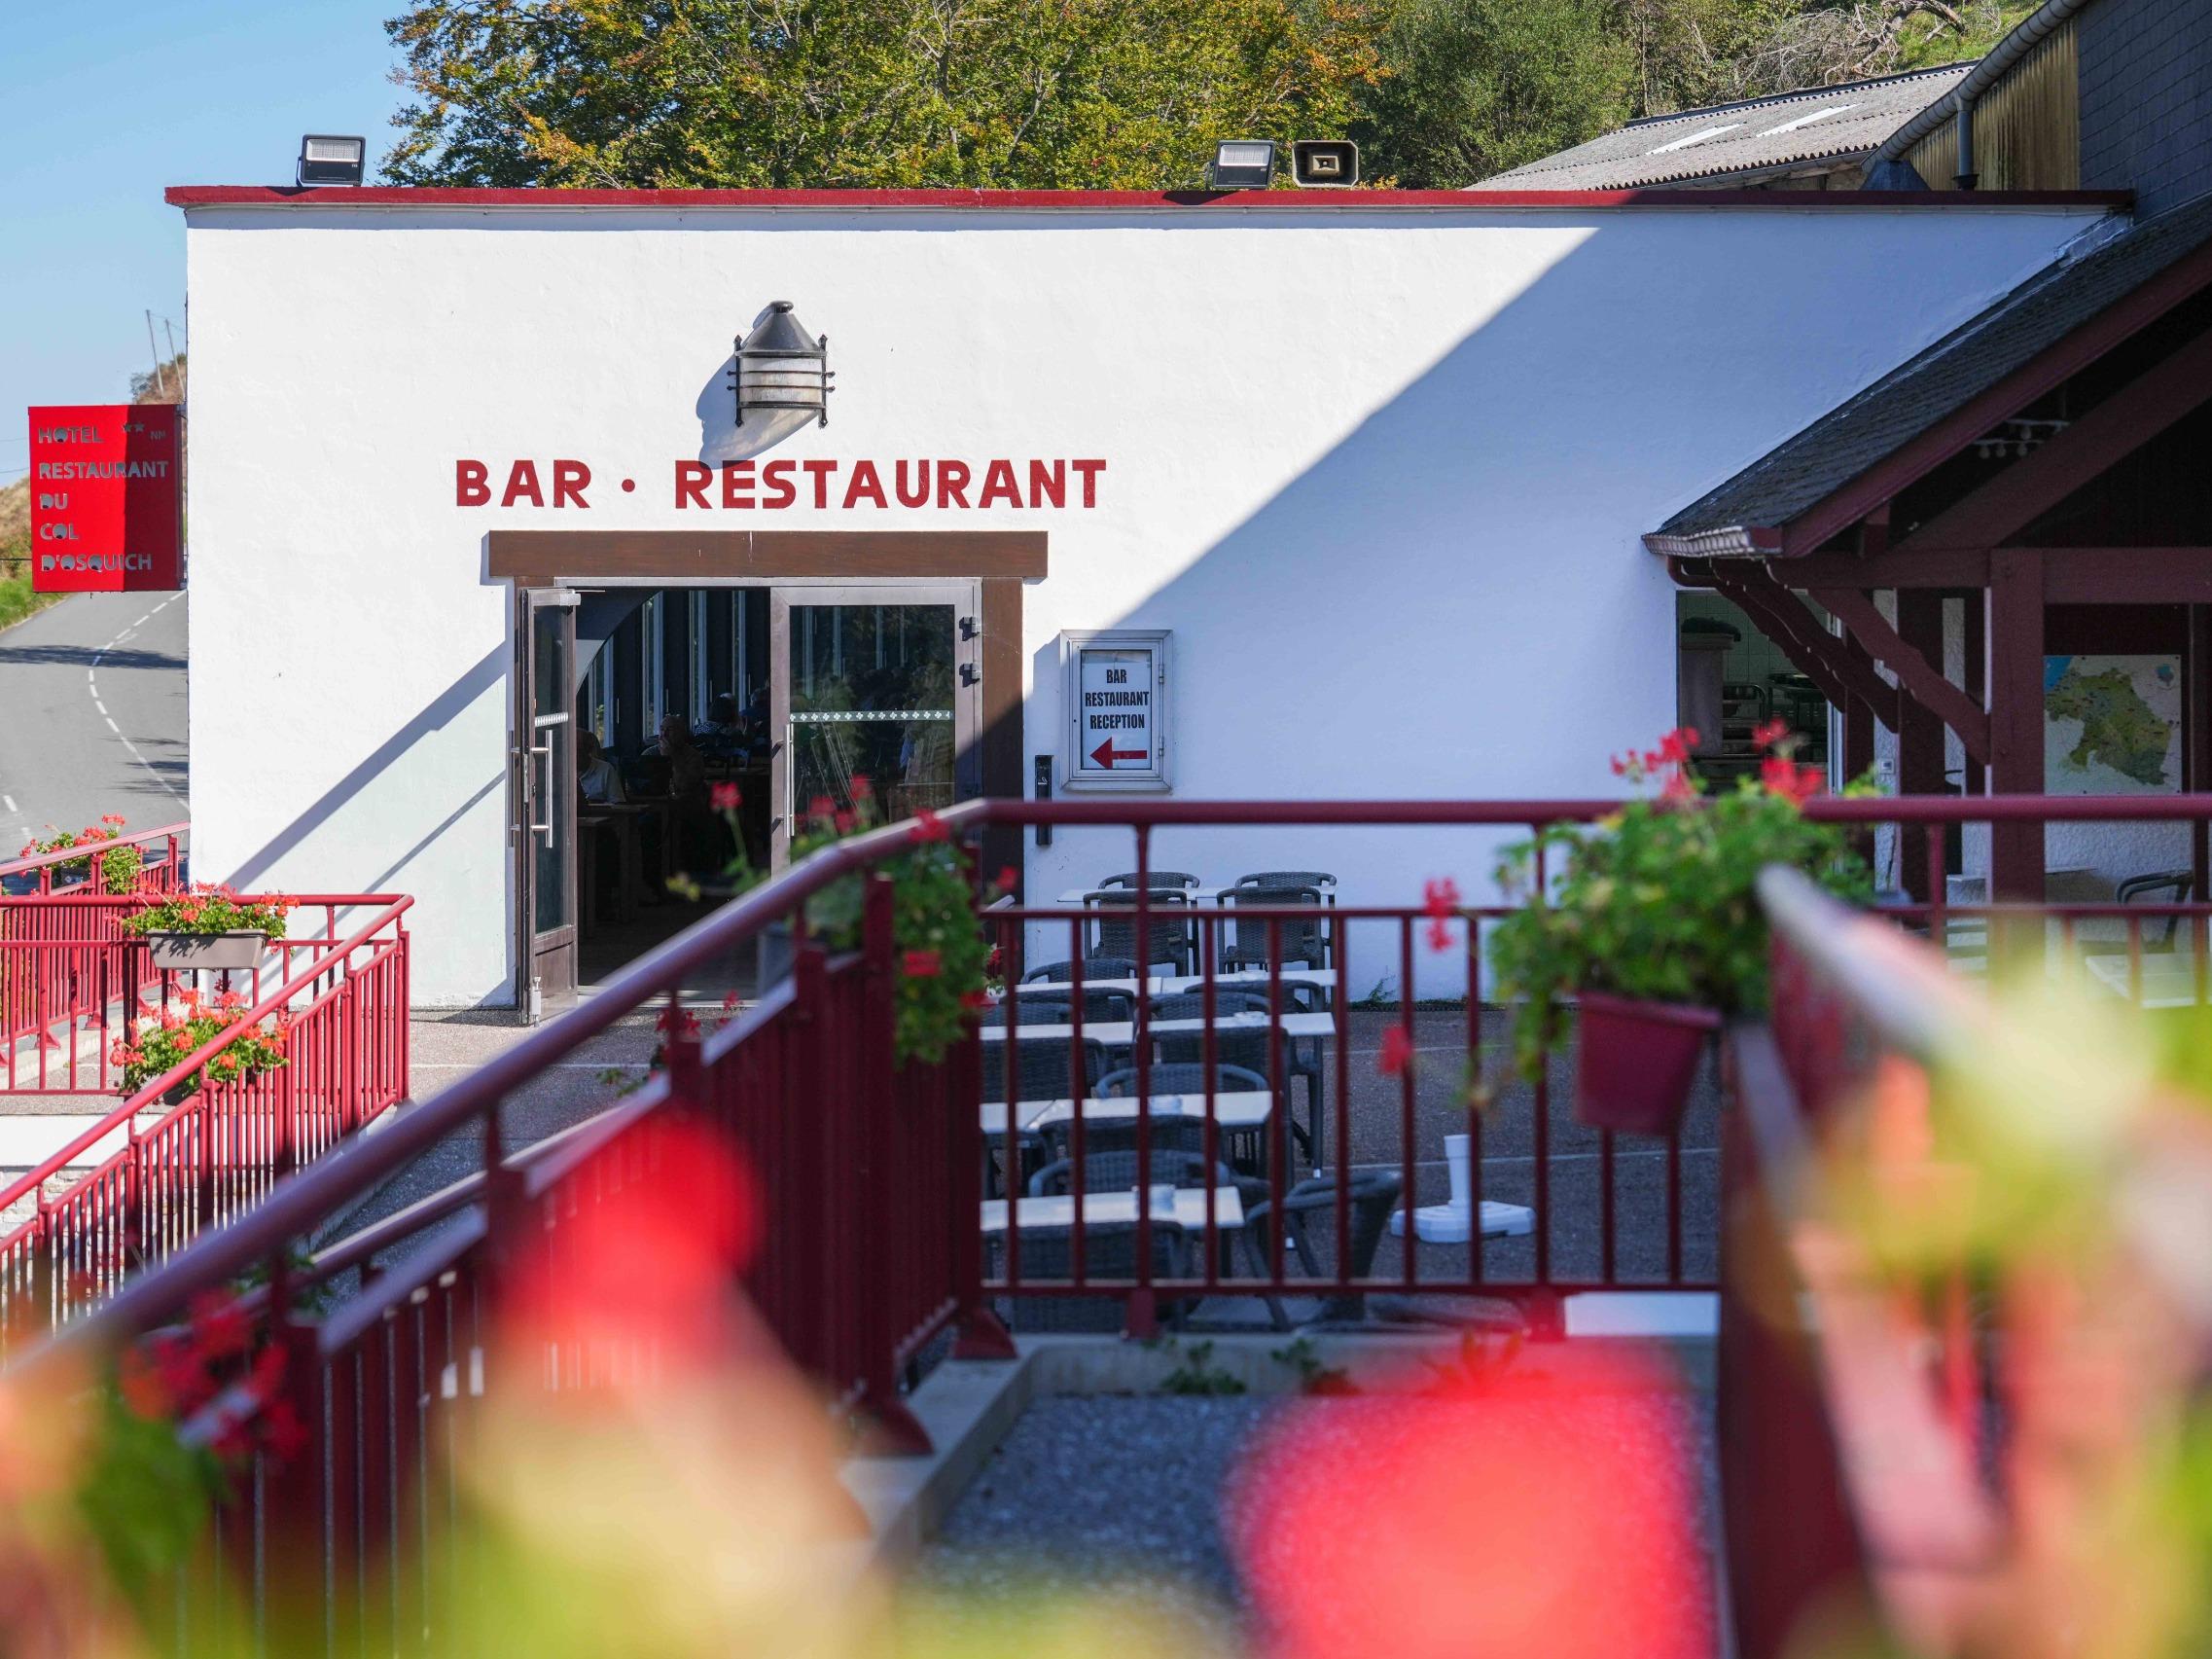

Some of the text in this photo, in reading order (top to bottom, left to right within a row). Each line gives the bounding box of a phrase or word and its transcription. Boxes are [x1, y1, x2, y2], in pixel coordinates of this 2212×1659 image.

[38, 426, 104, 444] HOTEL
[39, 460, 169, 480] RESTAURANT
[456, 458, 1107, 510] BAR RESTAURANT
[39, 492, 68, 510] DU
[39, 523, 80, 540] COL
[41, 553, 153, 572] D'OSQUICH
[1106, 668, 1127, 684] BAR
[1085, 691, 1150, 707] RESTAURANT
[1089, 713, 1145, 730] RECEPTION
